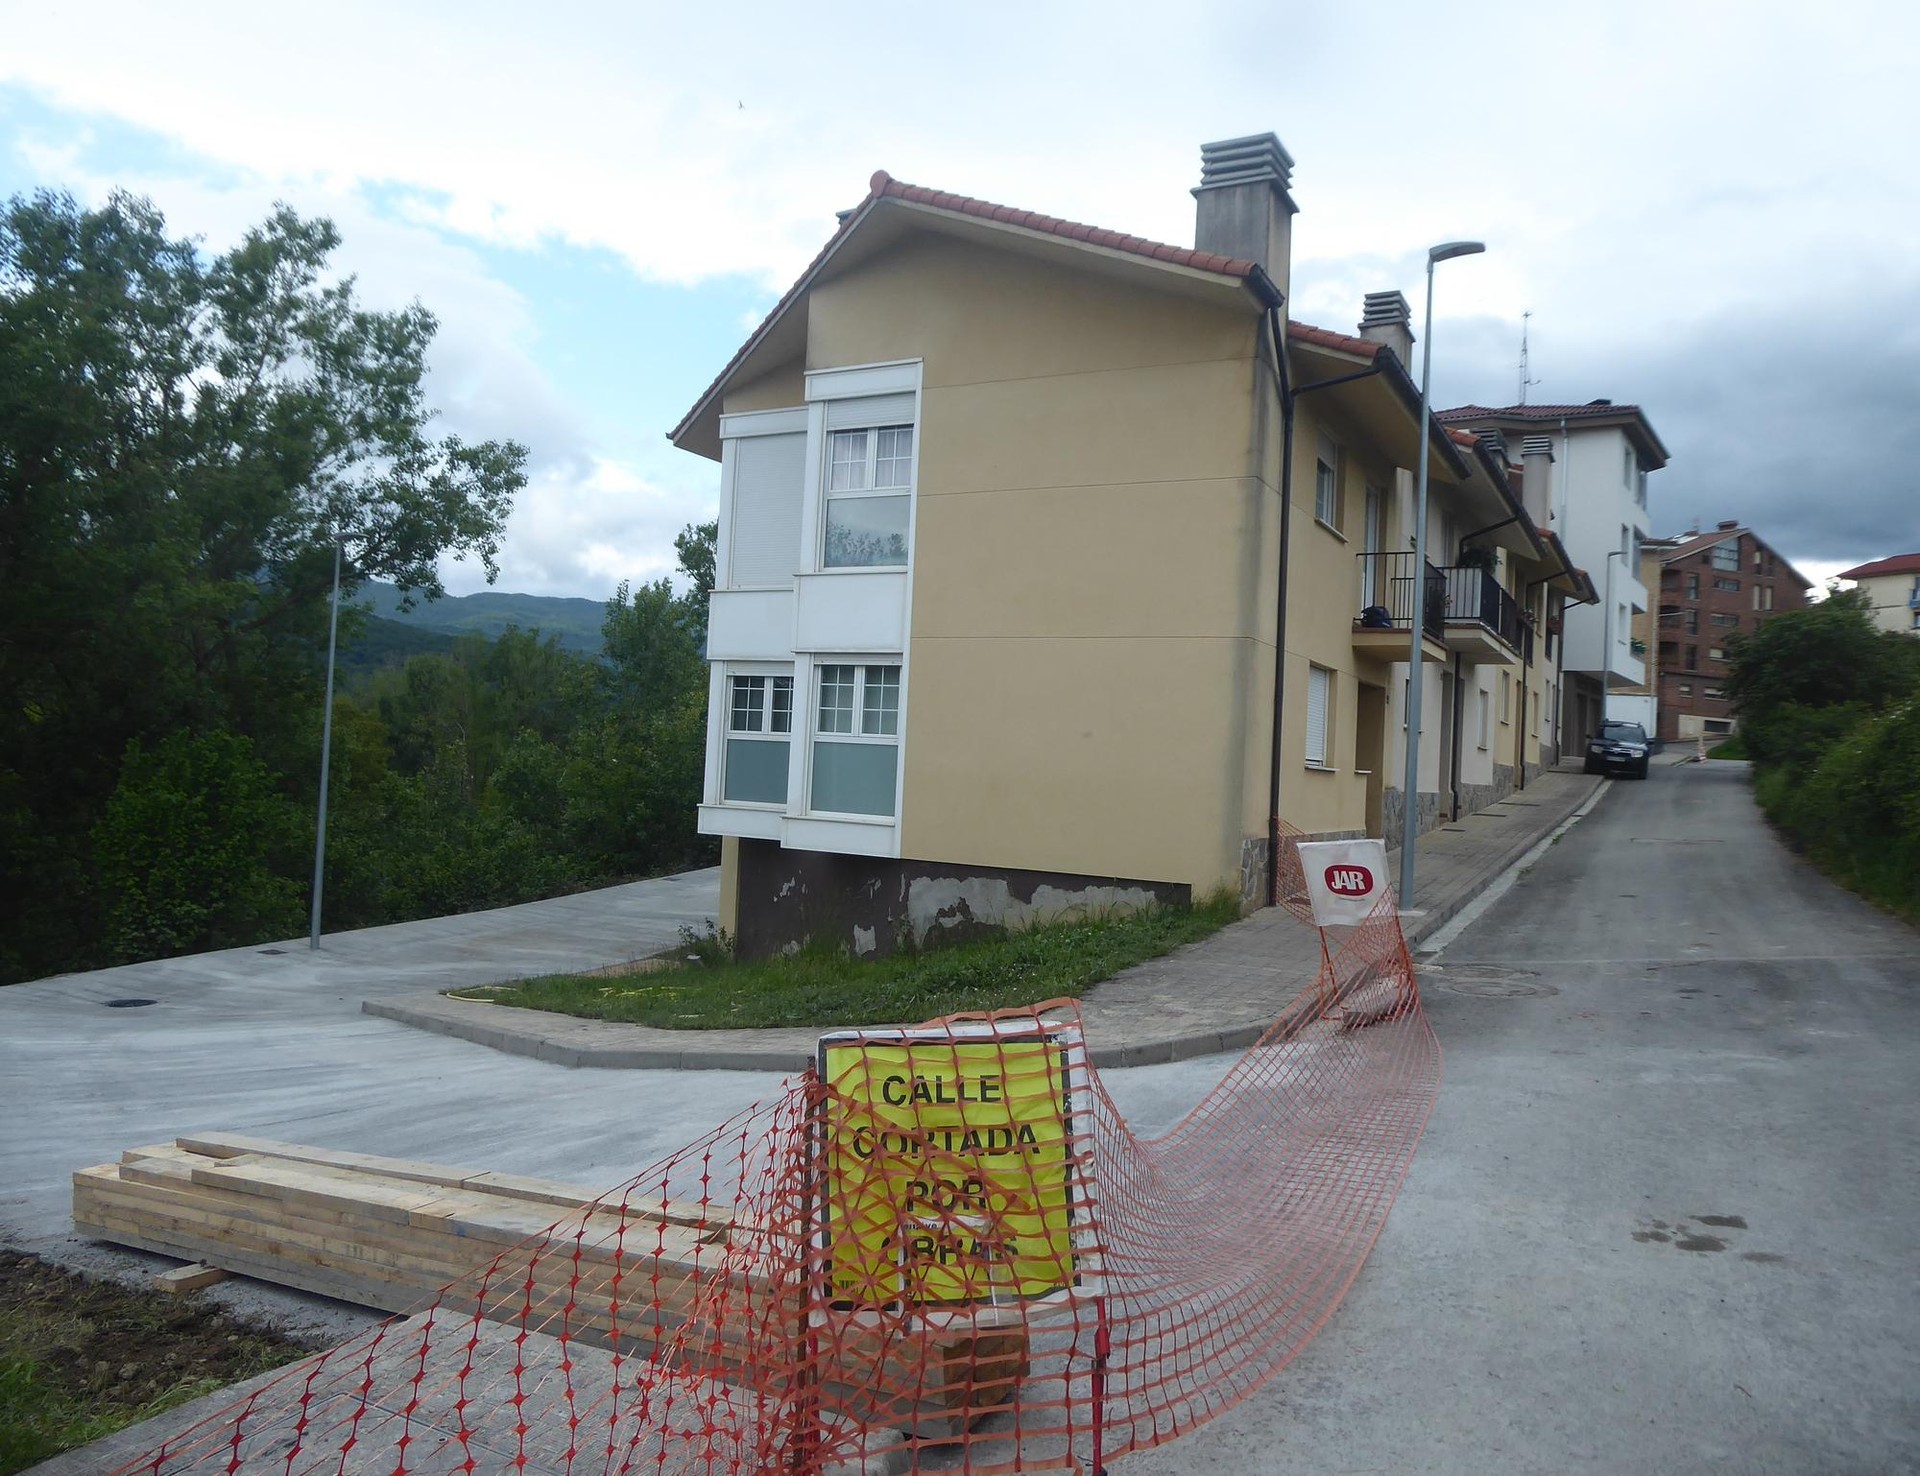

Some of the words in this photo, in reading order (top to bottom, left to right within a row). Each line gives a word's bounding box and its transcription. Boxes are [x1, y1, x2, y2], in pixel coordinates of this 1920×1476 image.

[1331, 870, 1366, 890] JAR
[882, 1075, 1002, 1106] CALLE
[906, 1178, 987, 1212] POR
